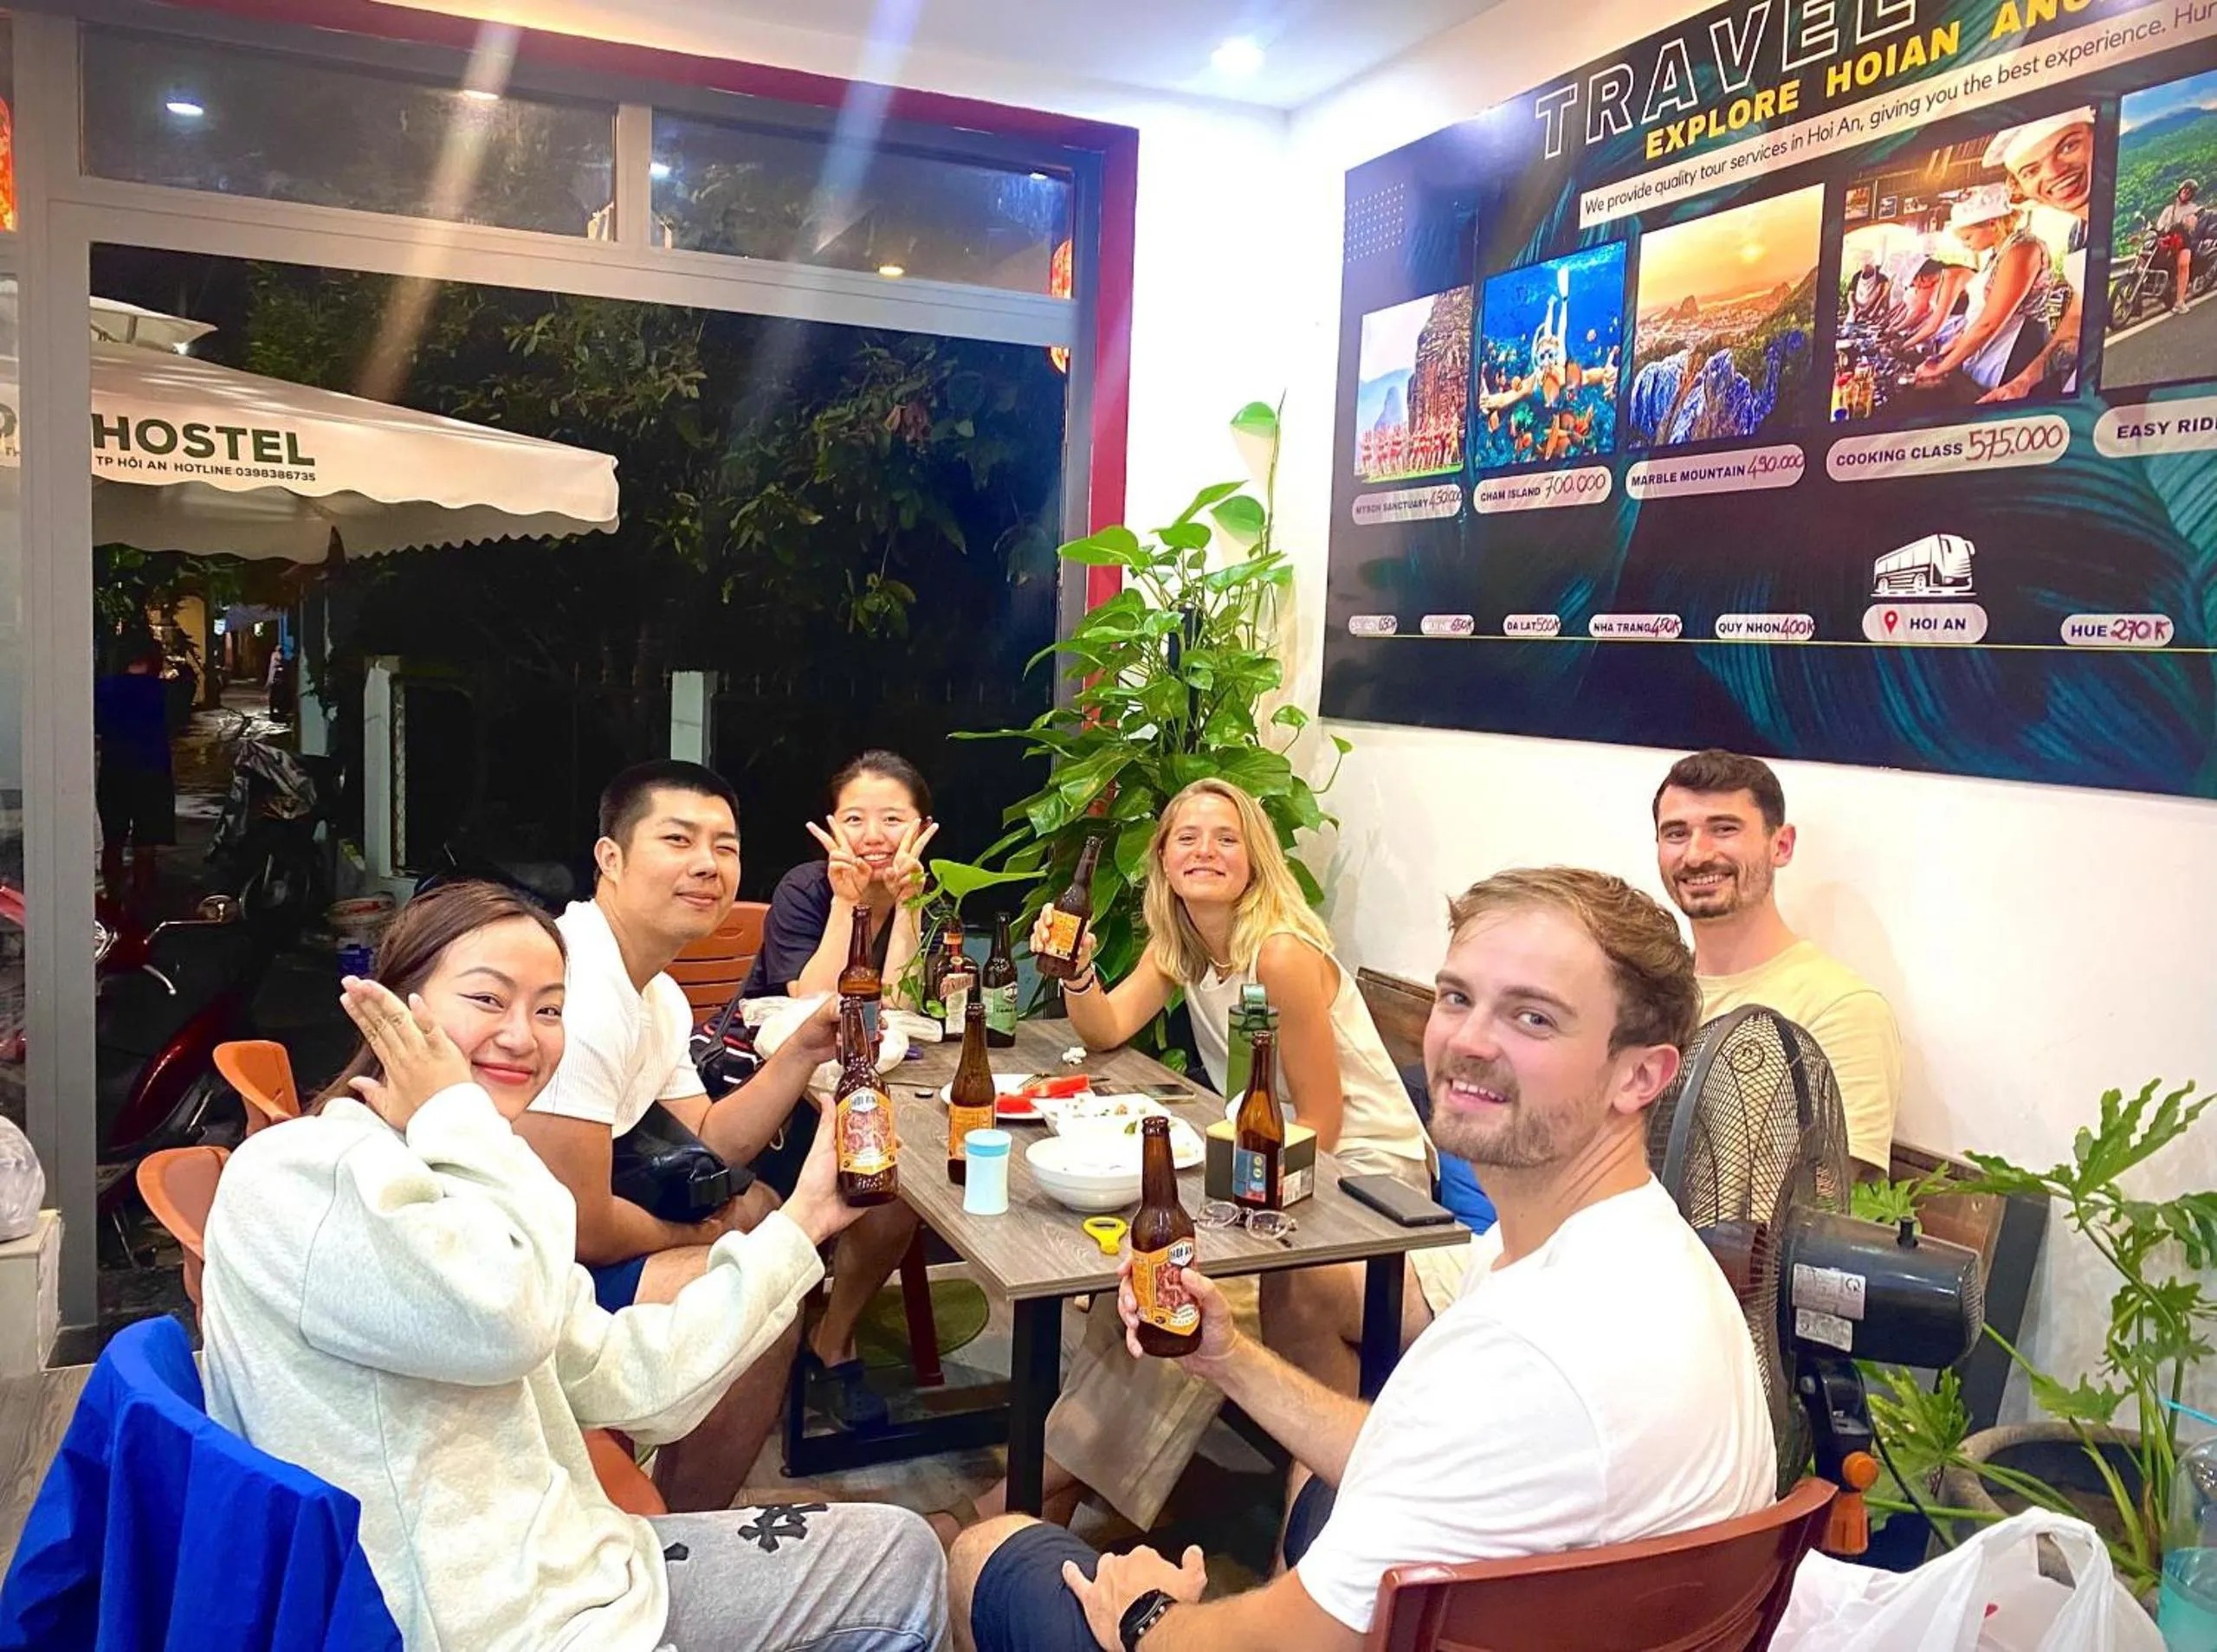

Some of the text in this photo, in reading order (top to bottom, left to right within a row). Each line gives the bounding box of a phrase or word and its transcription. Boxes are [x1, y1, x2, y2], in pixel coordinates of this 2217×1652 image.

[1646, 79, 1800, 160] EXPLORE
[1826, 21, 1961, 98] HOIAN
[1586, 200, 1605, 215] We
[1607, 183, 1651, 210] provide
[1655, 169, 1697, 195] quality
[1701, 161, 1727, 179] tour
[1730, 145, 1787, 170] services
[1791, 134, 1804, 149] in
[1807, 122, 1834, 144] Hoi
[1837, 117, 1864, 137] An,
[1871, 100, 1920, 128] giving
[1925, 87, 1958, 109] you
[1964, 70, 1993, 96] the
[1998, 57, 2040, 84] best
[2045, 19, 2166, 68] experience.
[2117, 416, 2217, 439] EASY RID
[92, 413, 315, 467] HOSTEL
[1966, 424, 2063, 461] 575.000
[96, 455, 113, 466] TP
[147, 461, 167, 470] AN
[1836, 443, 1963, 466] COOKING CLASS
[1544, 474, 1607, 499] 700.000
[1631, 465, 1745, 487] MARBLE MOUNTAIN
[1480, 486, 1542, 502] CHAM ISLAND
[1521, 621, 1536, 631] LAT
[1593, 623, 1651, 633] NHA TRANG
[1718, 622, 1781, 634] QUY NHON
[1910, 618, 1966, 630] HOI AN
[2071, 624, 2108, 638] HUE
